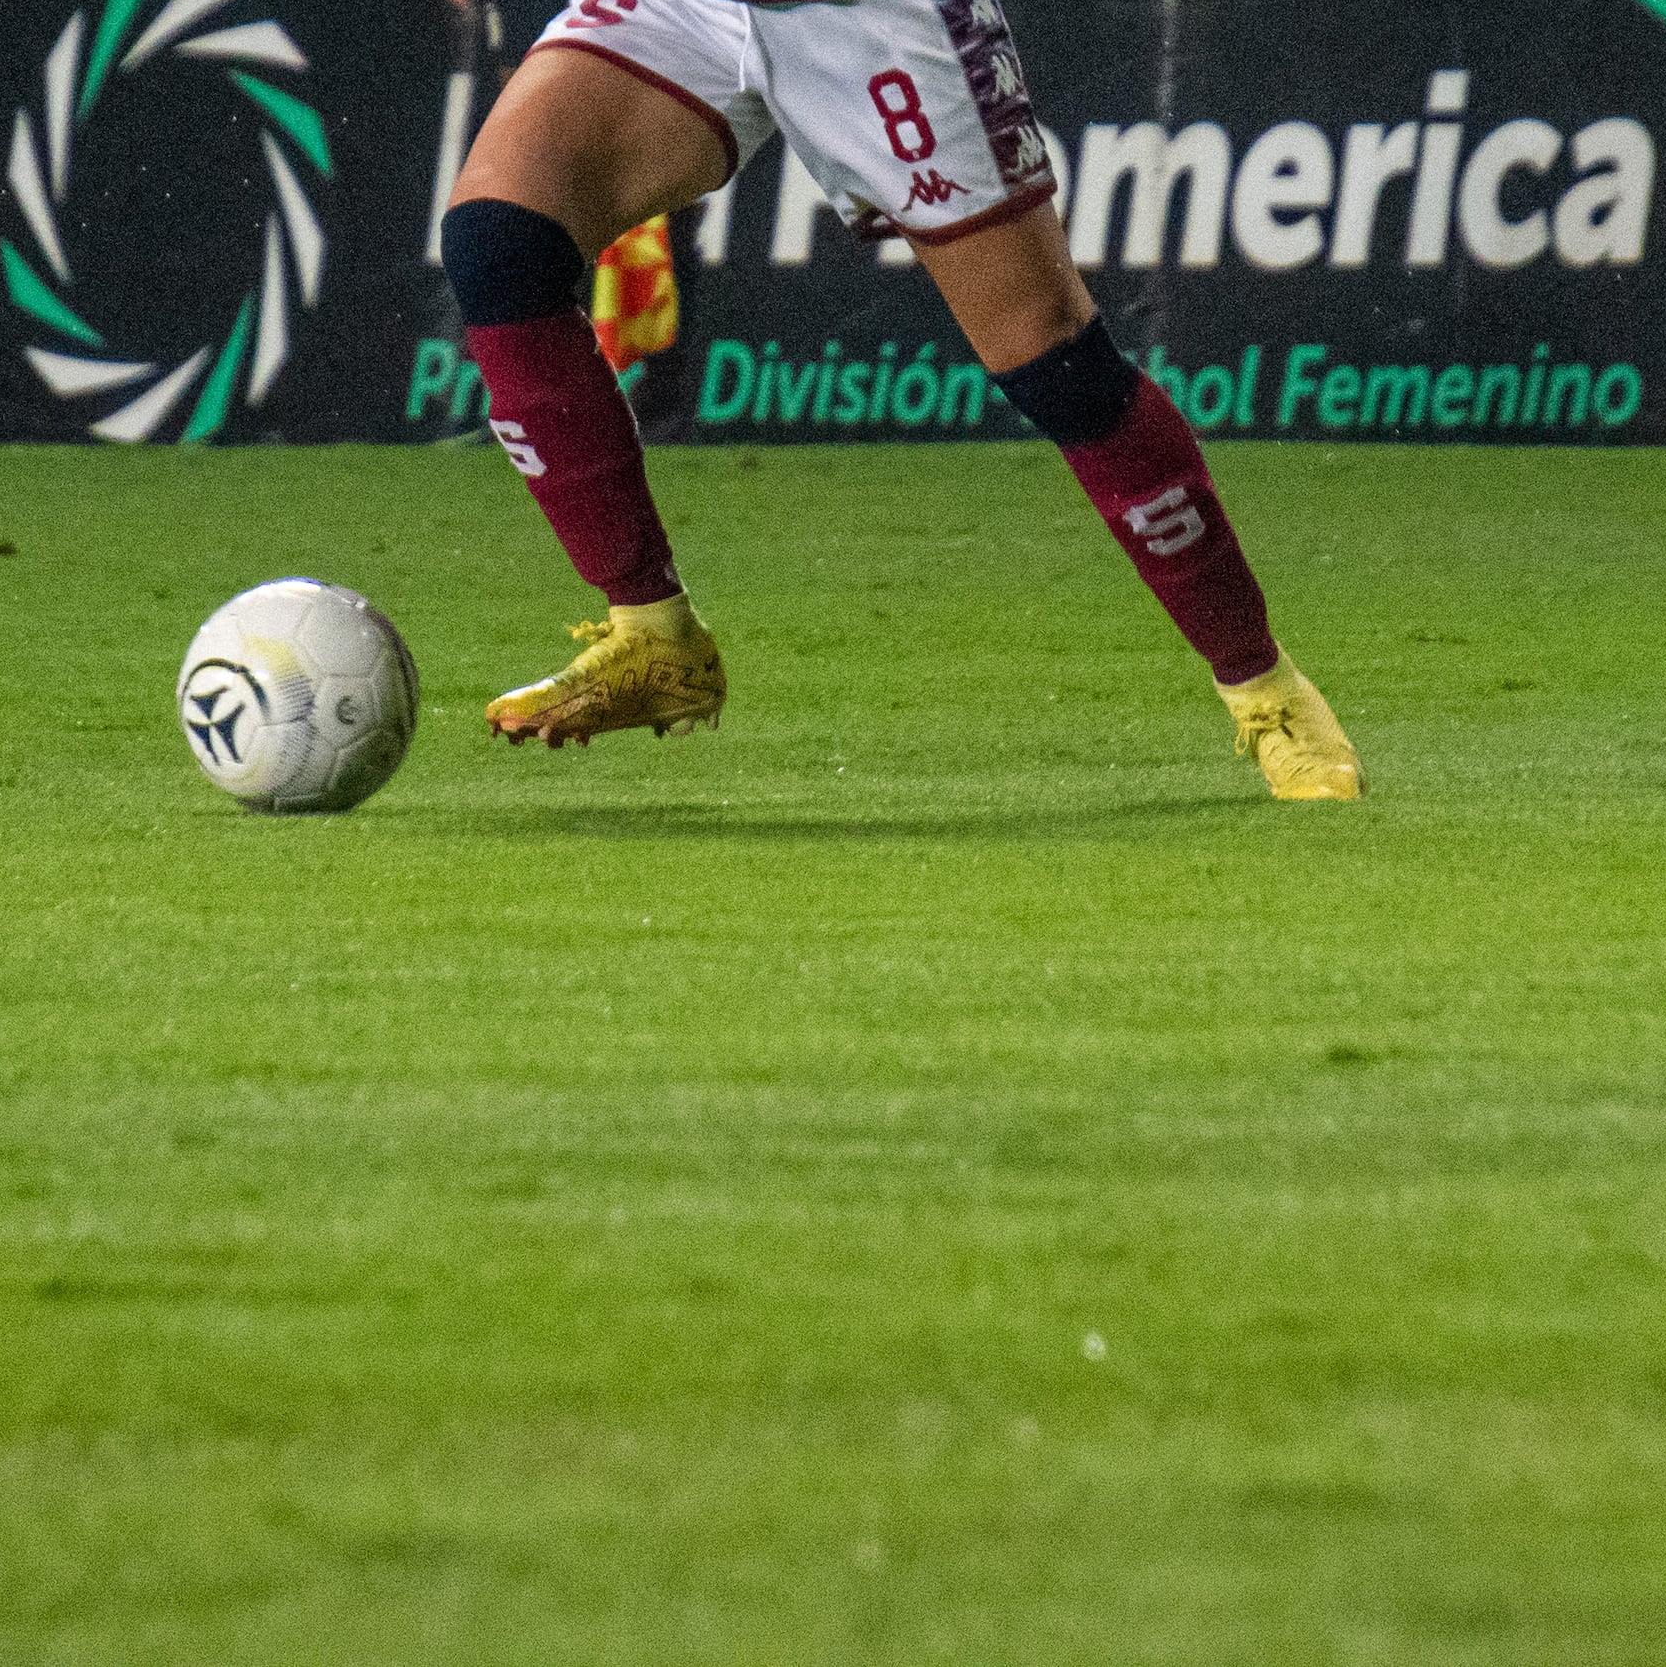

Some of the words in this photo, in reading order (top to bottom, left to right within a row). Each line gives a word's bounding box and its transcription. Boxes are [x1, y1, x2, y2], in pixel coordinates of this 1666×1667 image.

[866, 67, 937, 163] 8
[770, 68, 1656, 271] merica
[697, 338, 986, 426] División
[1276, 342, 1644, 430] Femenino
[1121, 484, 1206, 556] S
